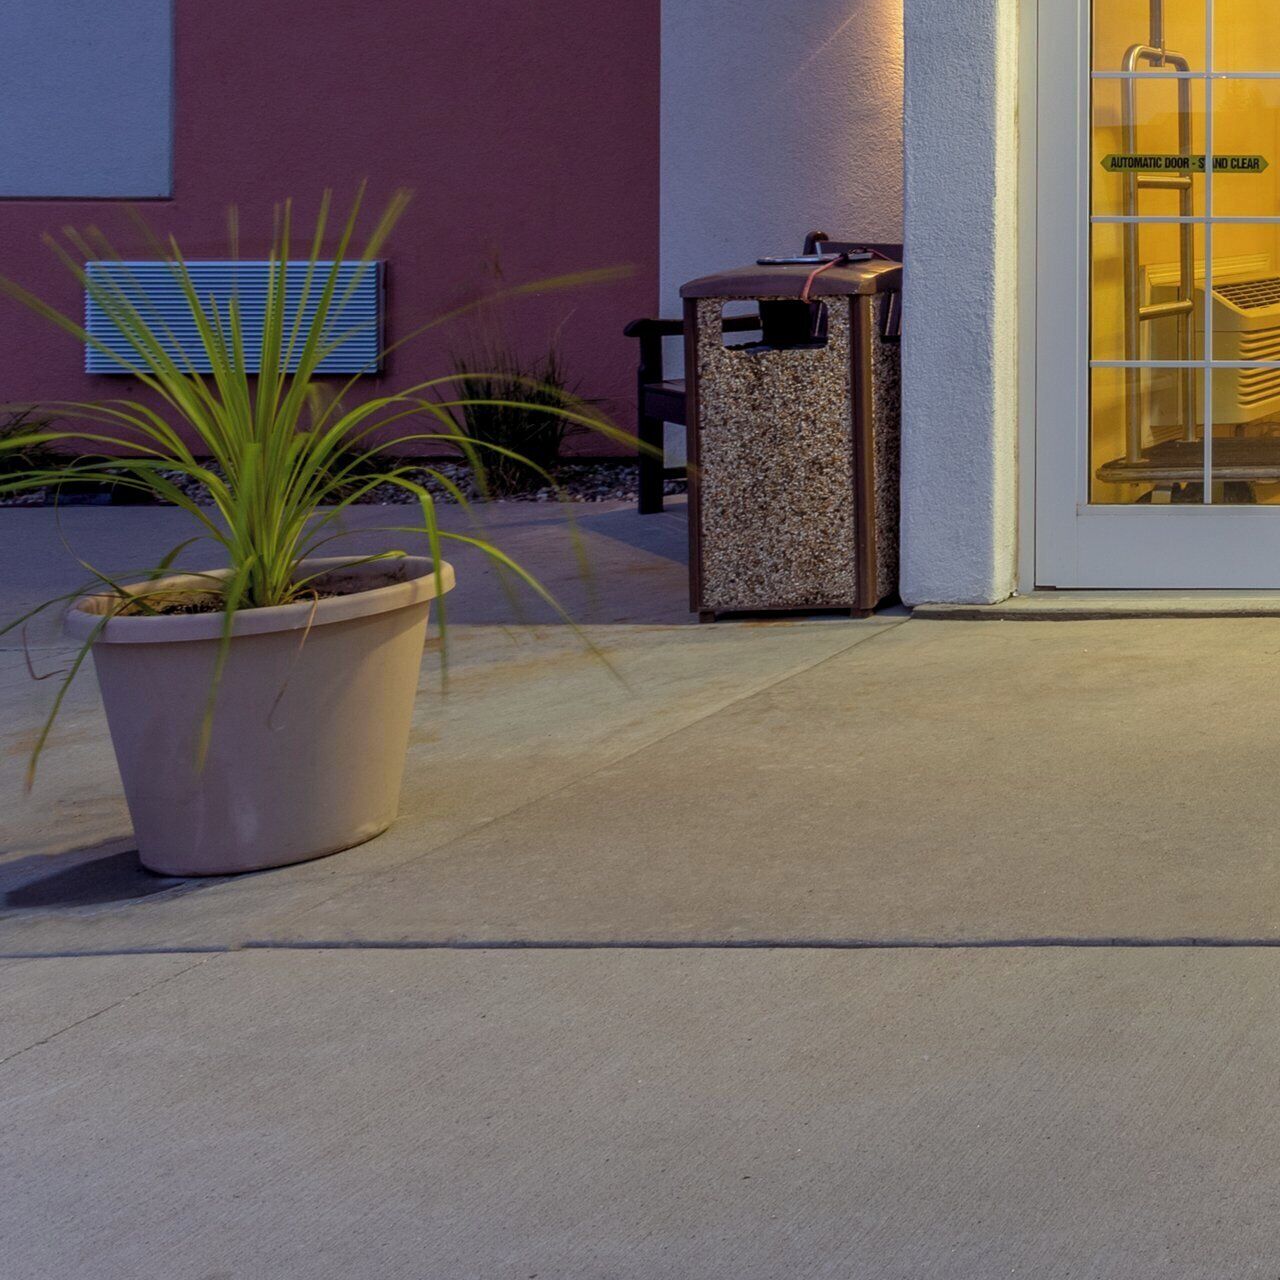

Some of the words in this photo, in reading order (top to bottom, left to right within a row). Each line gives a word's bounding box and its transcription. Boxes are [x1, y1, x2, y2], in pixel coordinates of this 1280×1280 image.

[1111, 157, 1162, 168] AUTOMATIC
[1165, 157, 1190, 169] DOOR
[1198, 157, 1228, 169] SND
[1231, 158, 1260, 169] CLEAR
